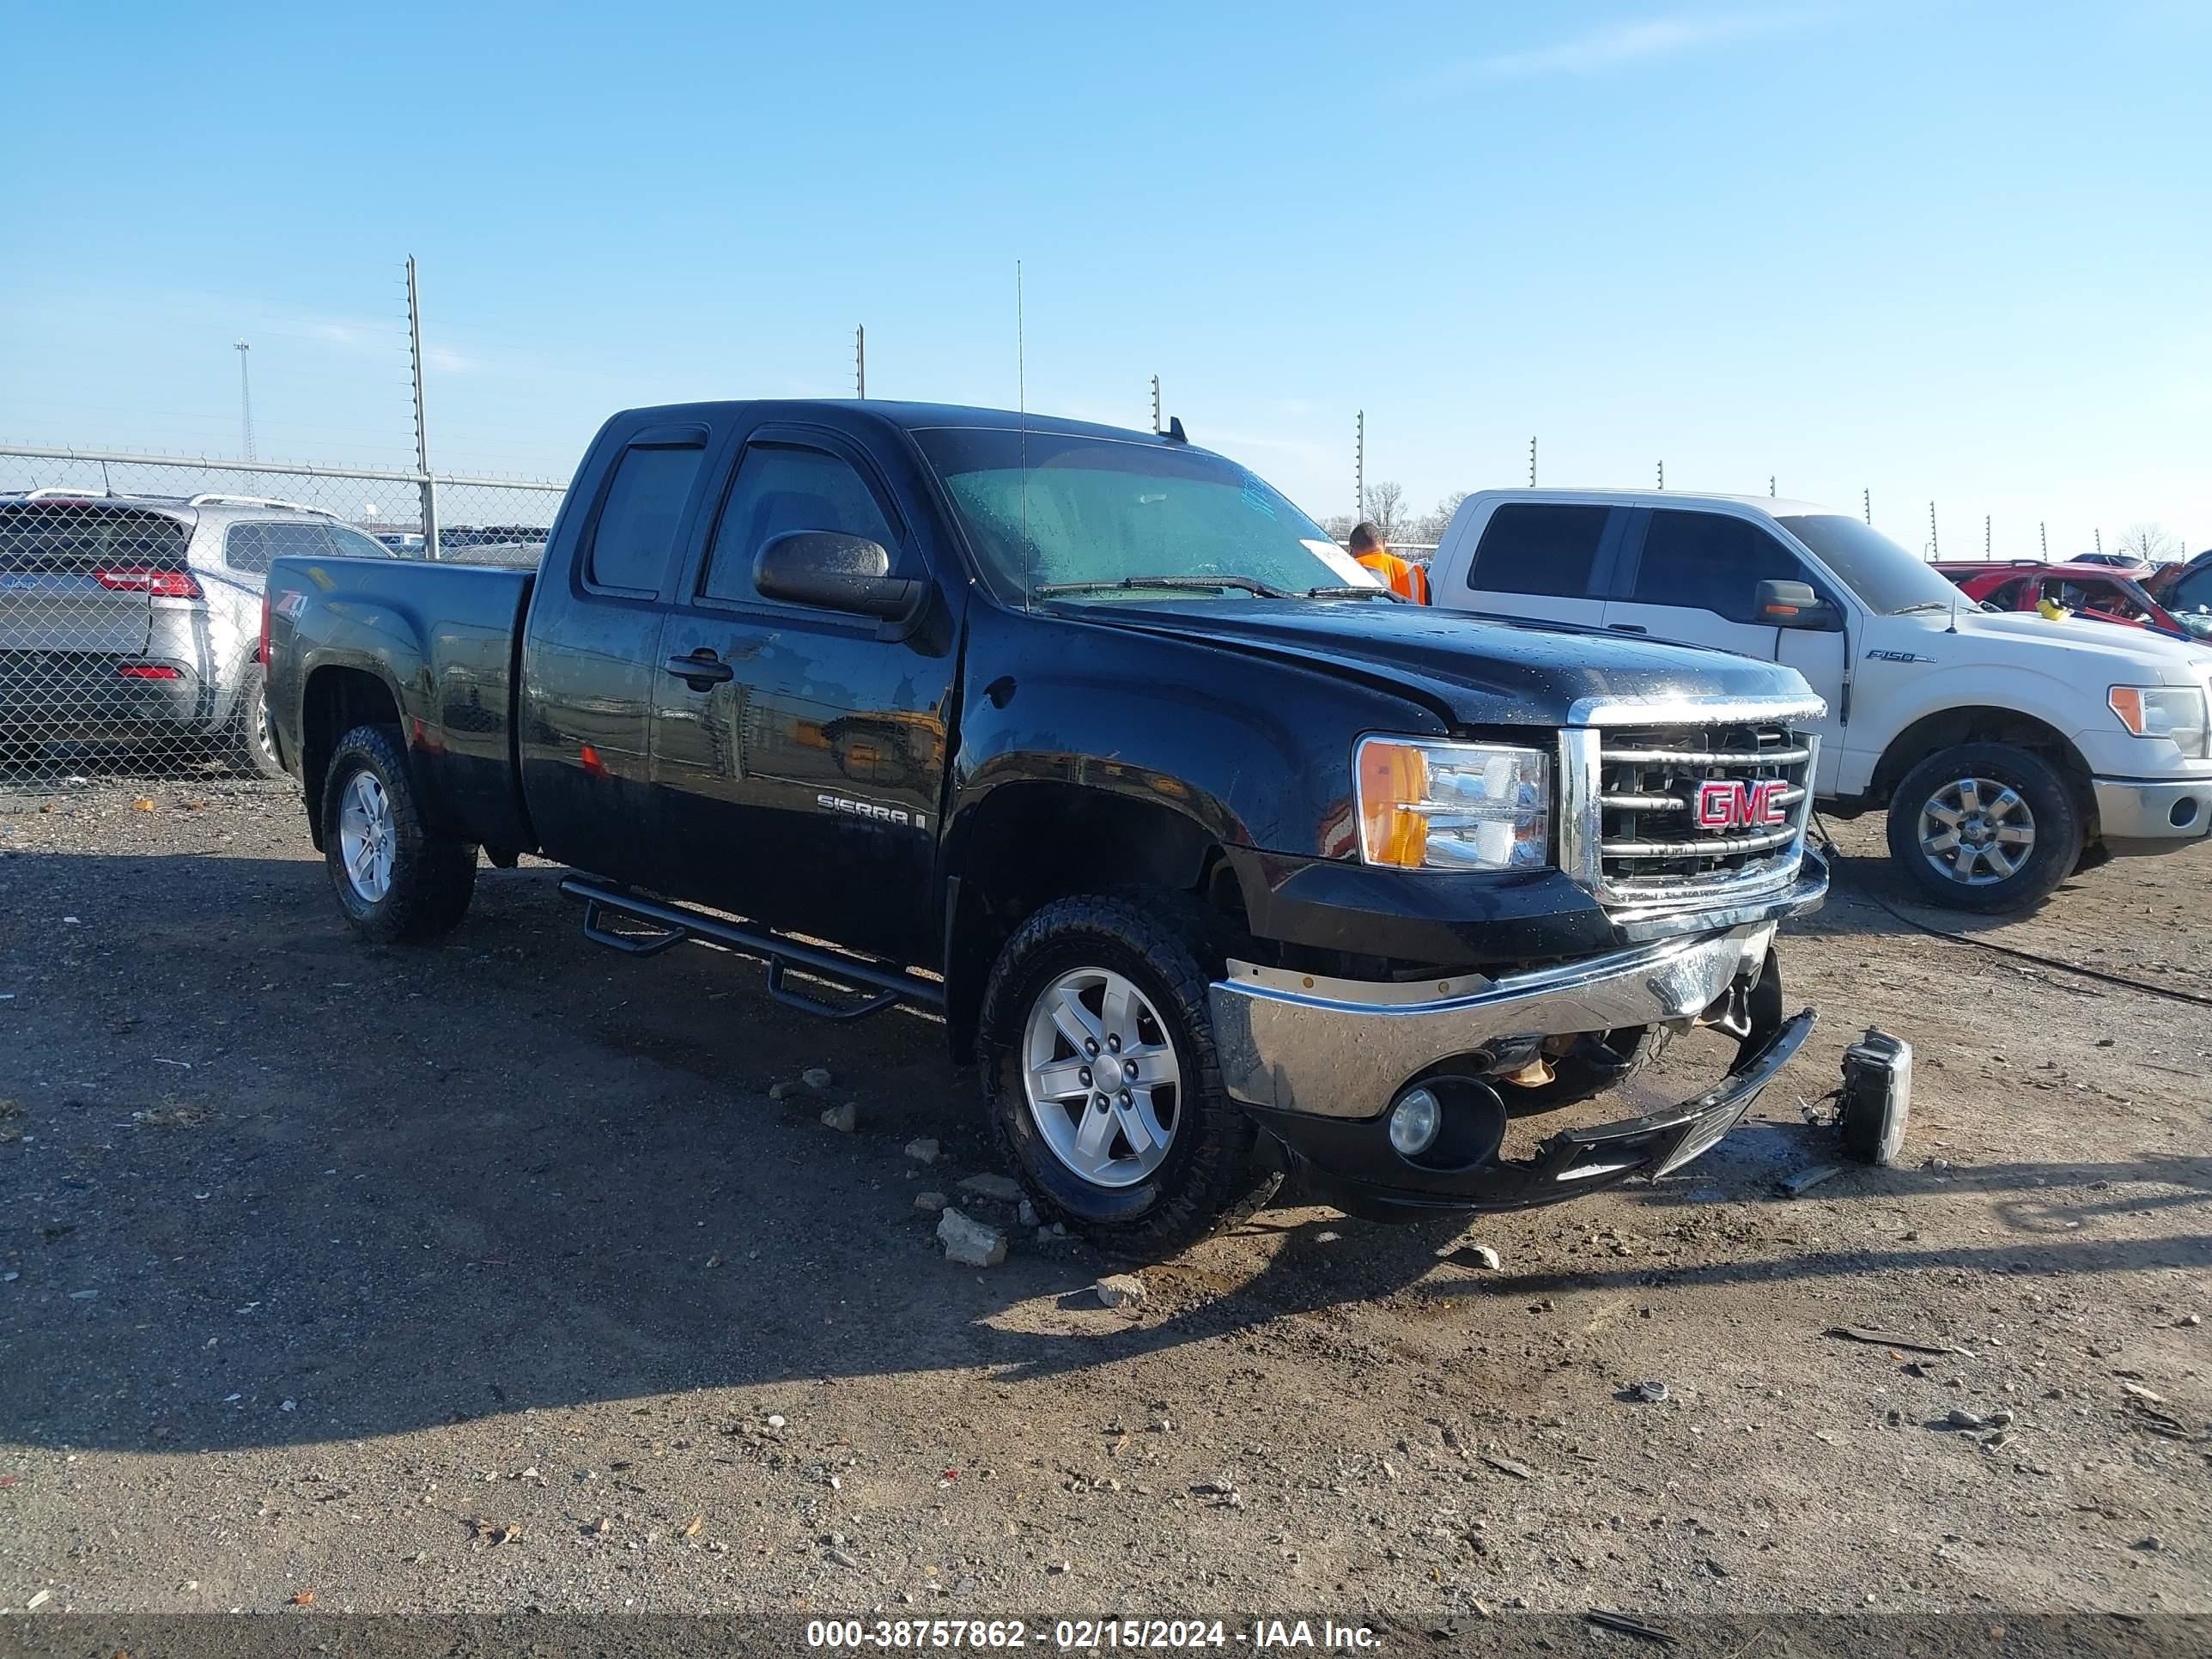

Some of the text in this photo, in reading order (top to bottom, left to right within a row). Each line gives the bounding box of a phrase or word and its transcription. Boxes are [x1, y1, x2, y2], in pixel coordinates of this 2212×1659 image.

[277, 590, 308, 611] Z71
[817, 793, 908, 826] SIERRA
[1693, 779, 1789, 830] GMC
